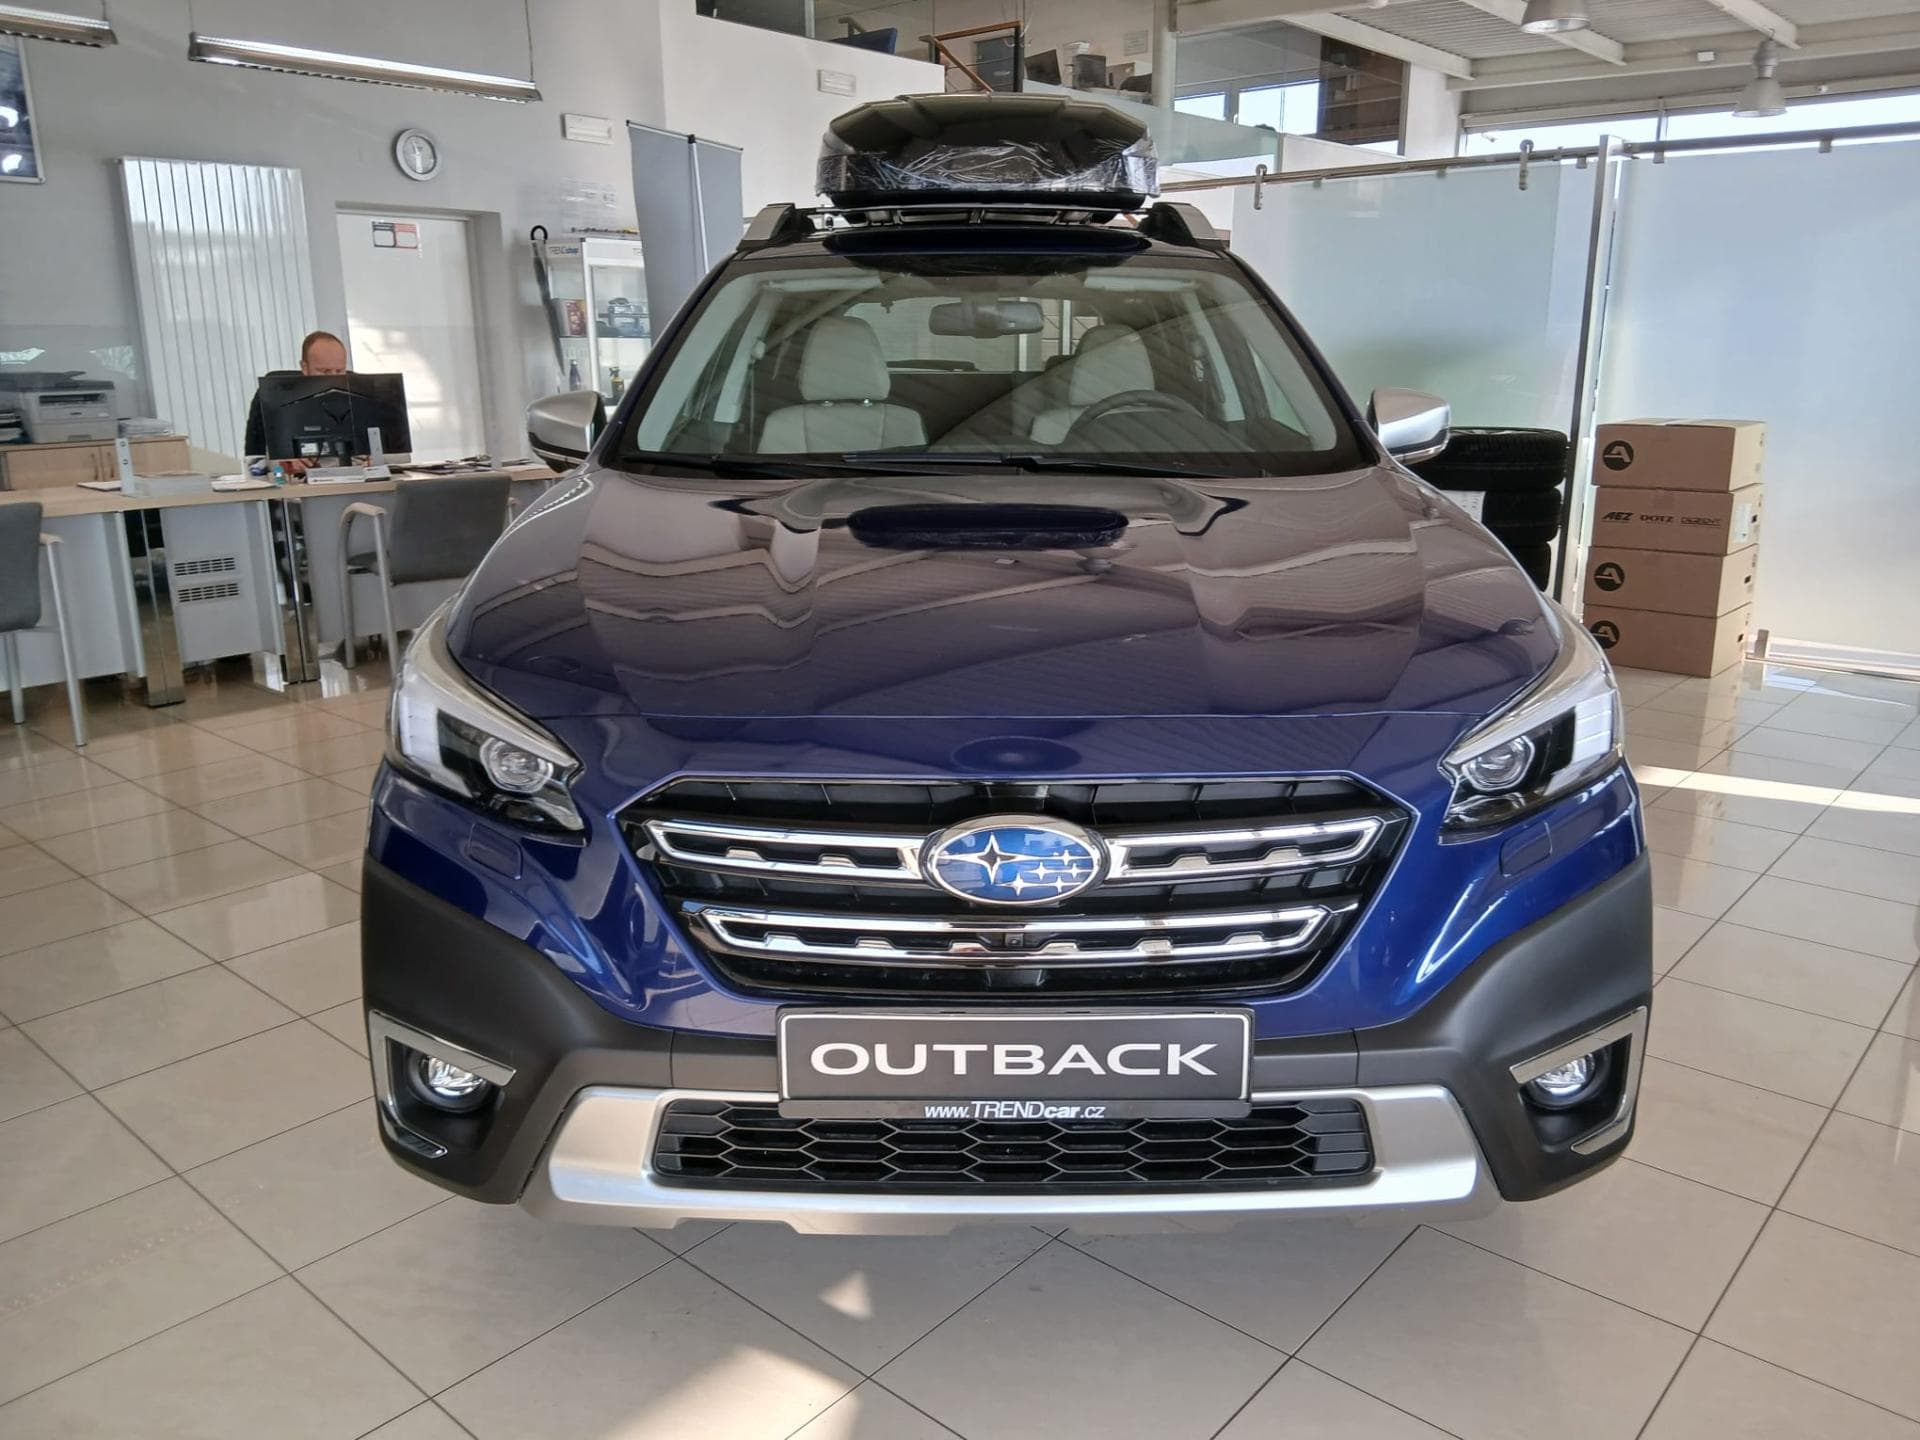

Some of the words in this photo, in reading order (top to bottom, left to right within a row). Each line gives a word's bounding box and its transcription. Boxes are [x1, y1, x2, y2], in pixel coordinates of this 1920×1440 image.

[1601, 511, 1633, 521] AEZ
[1640, 514, 1674, 523] DOTZ
[810, 1042, 1218, 1076] OUTBACK
[924, 1100, 1106, 1119] www.TRENDcar.cz
